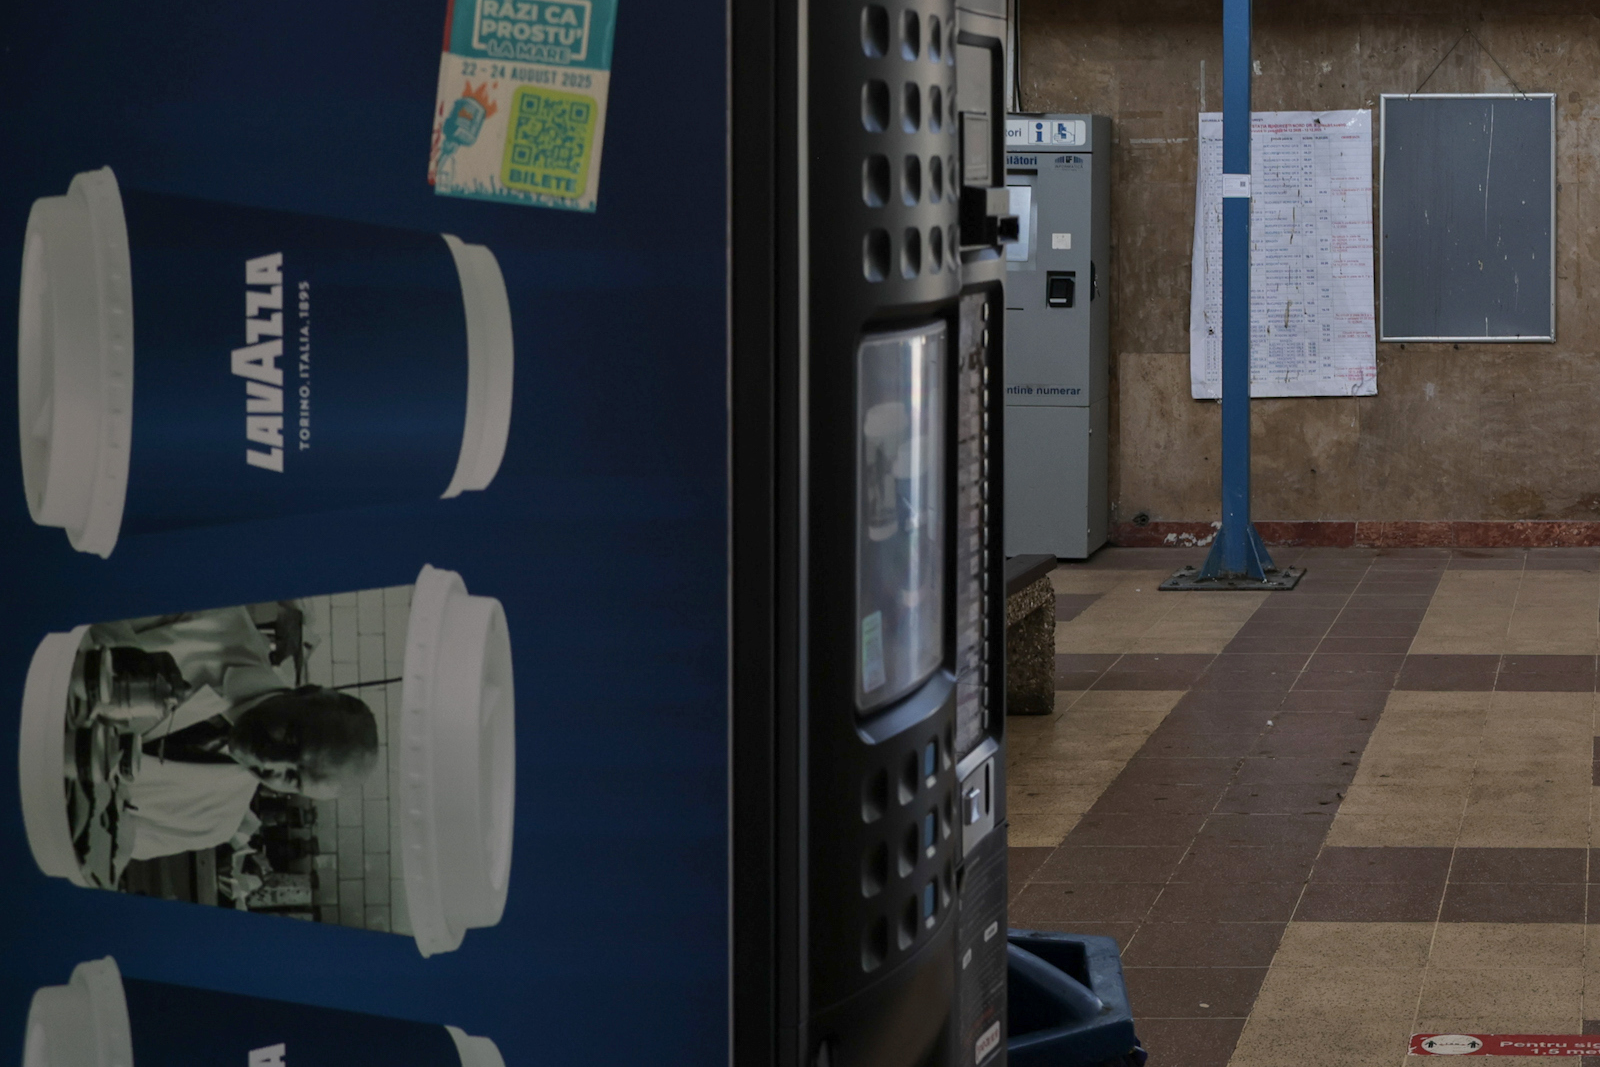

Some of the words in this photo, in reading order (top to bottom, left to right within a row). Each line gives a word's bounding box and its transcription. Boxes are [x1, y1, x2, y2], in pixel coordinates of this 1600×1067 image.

[545, 5, 578, 27] CA
[487, 38, 515, 59] LA
[515, 41, 571, 65] MARE
[461, 61, 478, 77] 22
[491, 63, 506, 79] 24
[510, 64, 558, 85] AUGUST
[562, 72, 594, 89] 2025
[1005, 128, 1021, 137] ori
[509, 168, 578, 194] BILETE
[299, 281, 310, 318] 1895
[231, 252, 283, 473] LAVAZZA
[1036, 386, 1081, 396] numerar
